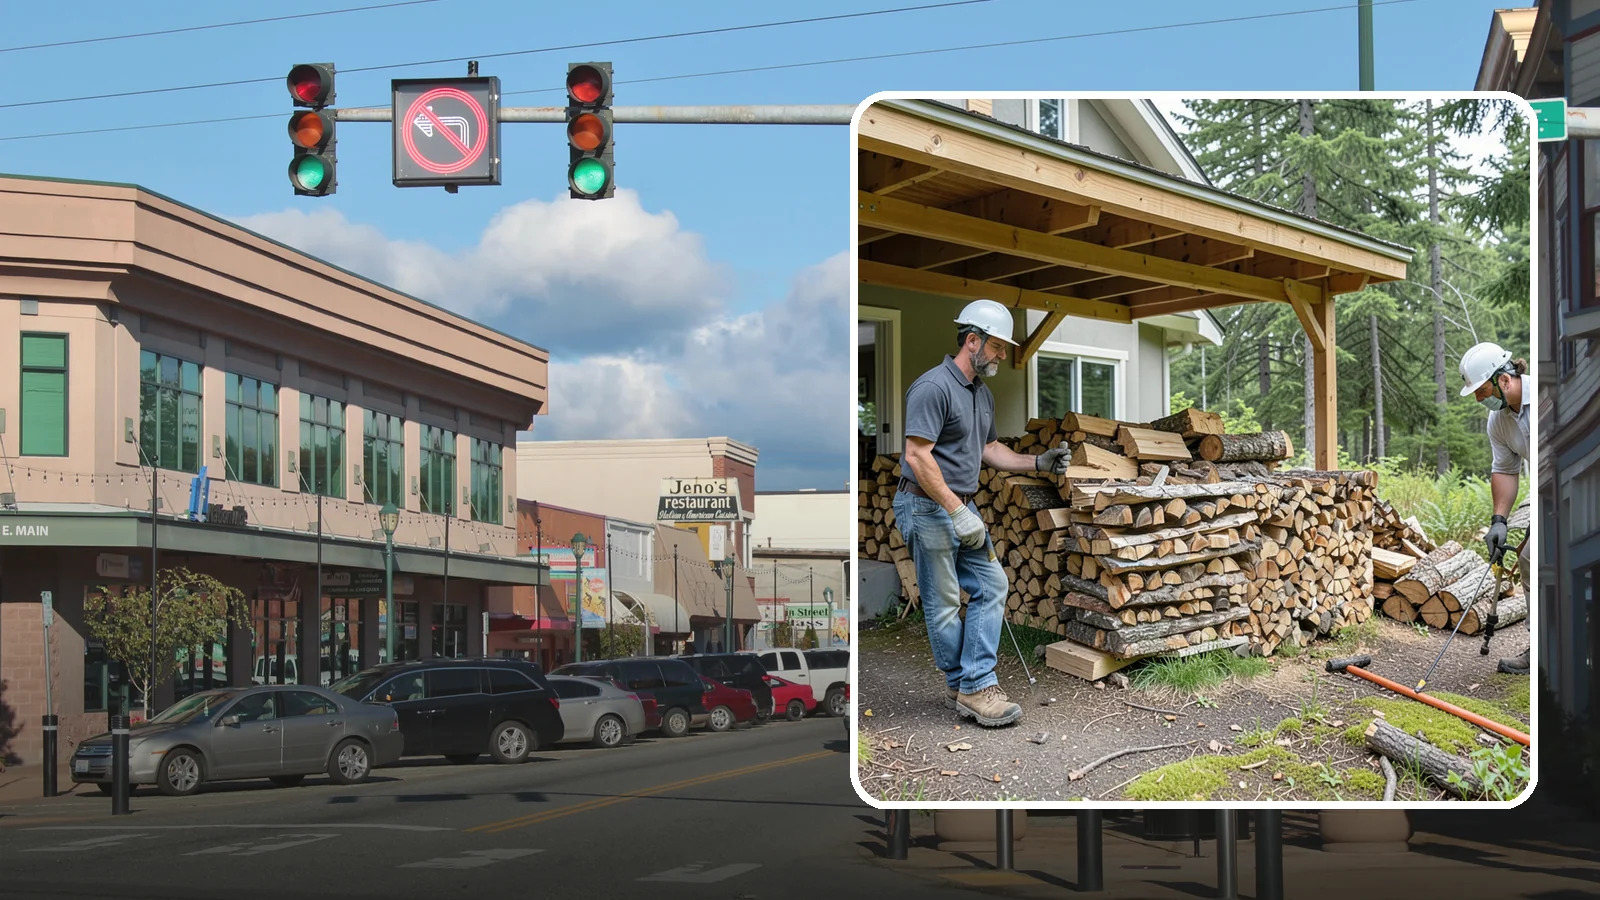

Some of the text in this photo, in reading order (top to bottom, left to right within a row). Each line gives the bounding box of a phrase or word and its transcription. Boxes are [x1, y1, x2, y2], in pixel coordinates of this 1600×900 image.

[669, 480, 727, 495] Jeno's
[665, 496, 731, 509] restaurant
[658, 510, 681, 519] Italian
[686, 509, 714, 519] American
[715, 509, 737, 519] Cuisine
[2, 525, 49, 536] E. MAIN
[797, 607, 829, 616] Street
